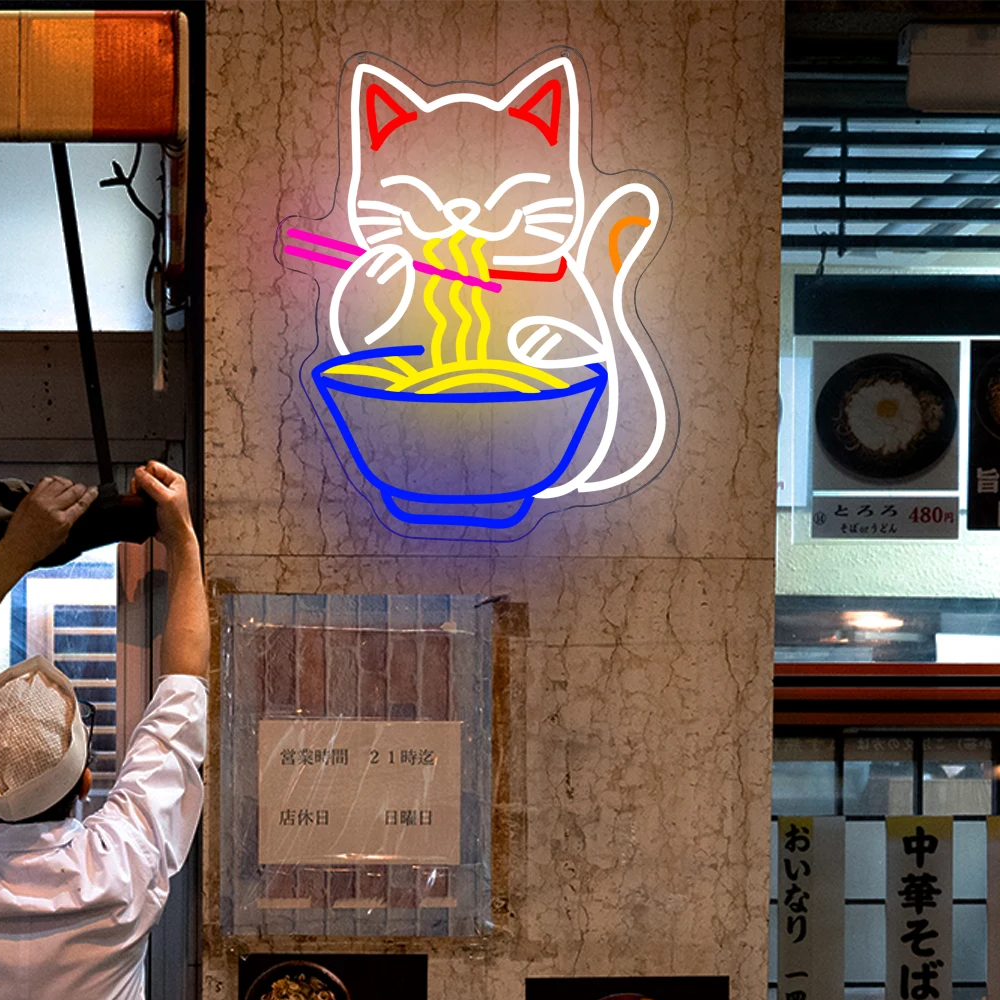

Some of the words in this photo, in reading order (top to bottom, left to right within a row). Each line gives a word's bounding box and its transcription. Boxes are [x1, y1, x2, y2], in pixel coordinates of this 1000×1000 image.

[834, 505, 897, 517] とろろ
[909, 507, 954, 523] 480円
[280, 749, 348, 766] 営業時間
[279, 809, 329, 826] 店休日
[385, 809, 432, 826] 日曜日
[784, 823, 811, 944] おいなり
[898, 826, 944, 1000] 中華そば
